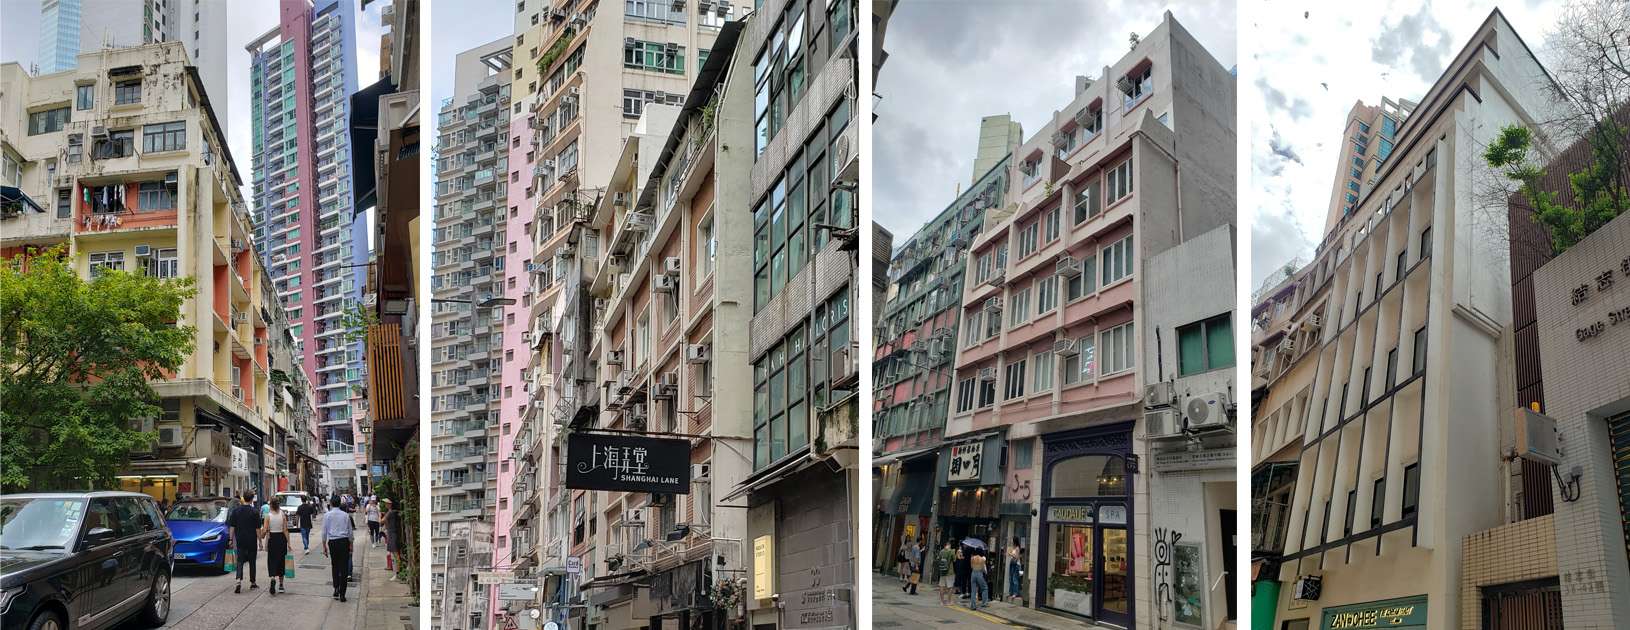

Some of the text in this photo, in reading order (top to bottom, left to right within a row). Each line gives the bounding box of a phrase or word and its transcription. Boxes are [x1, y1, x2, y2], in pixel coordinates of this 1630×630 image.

[1576, 321, 1605, 342] Gage
[620, 474, 680, 485] SHANGHAI LANE
